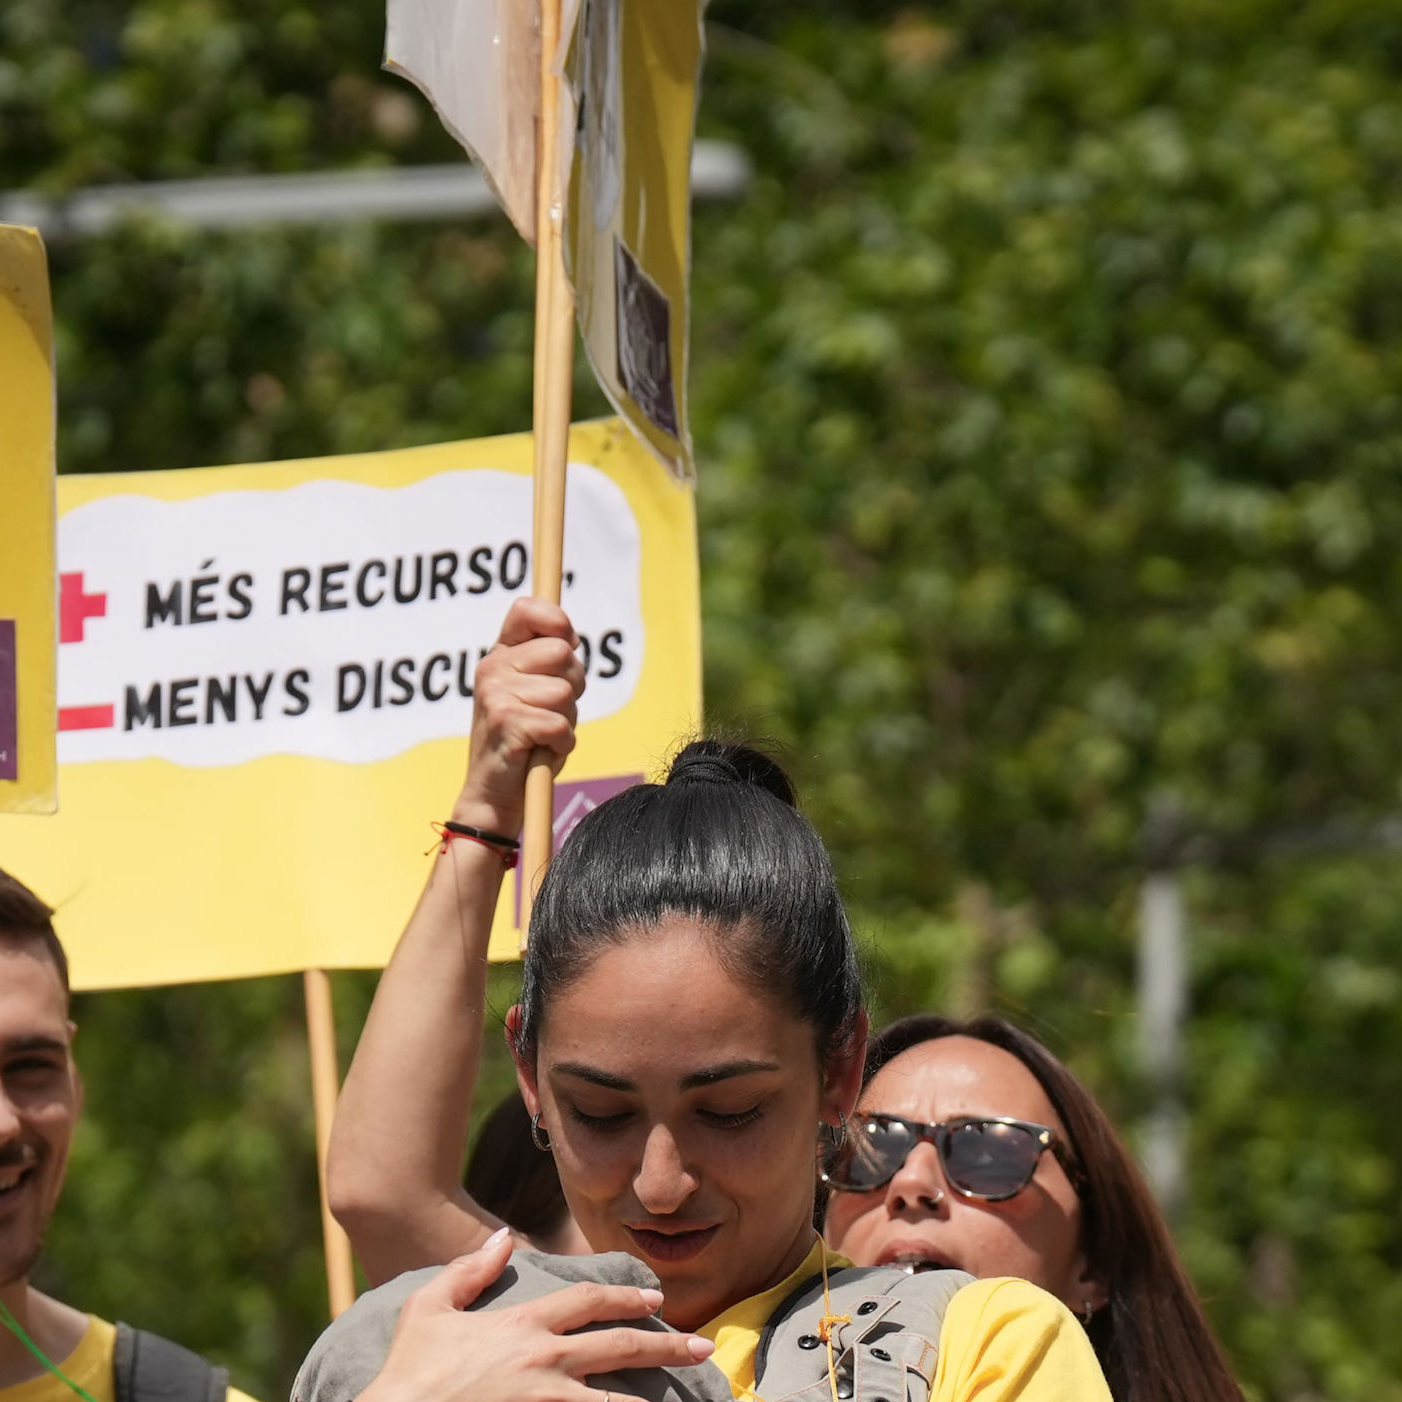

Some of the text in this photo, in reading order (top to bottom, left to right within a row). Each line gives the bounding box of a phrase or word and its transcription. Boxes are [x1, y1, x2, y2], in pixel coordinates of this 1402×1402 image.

[144, 541, 575, 629] MÉS RECURSO,
[124, 667, 311, 731] MENYS
